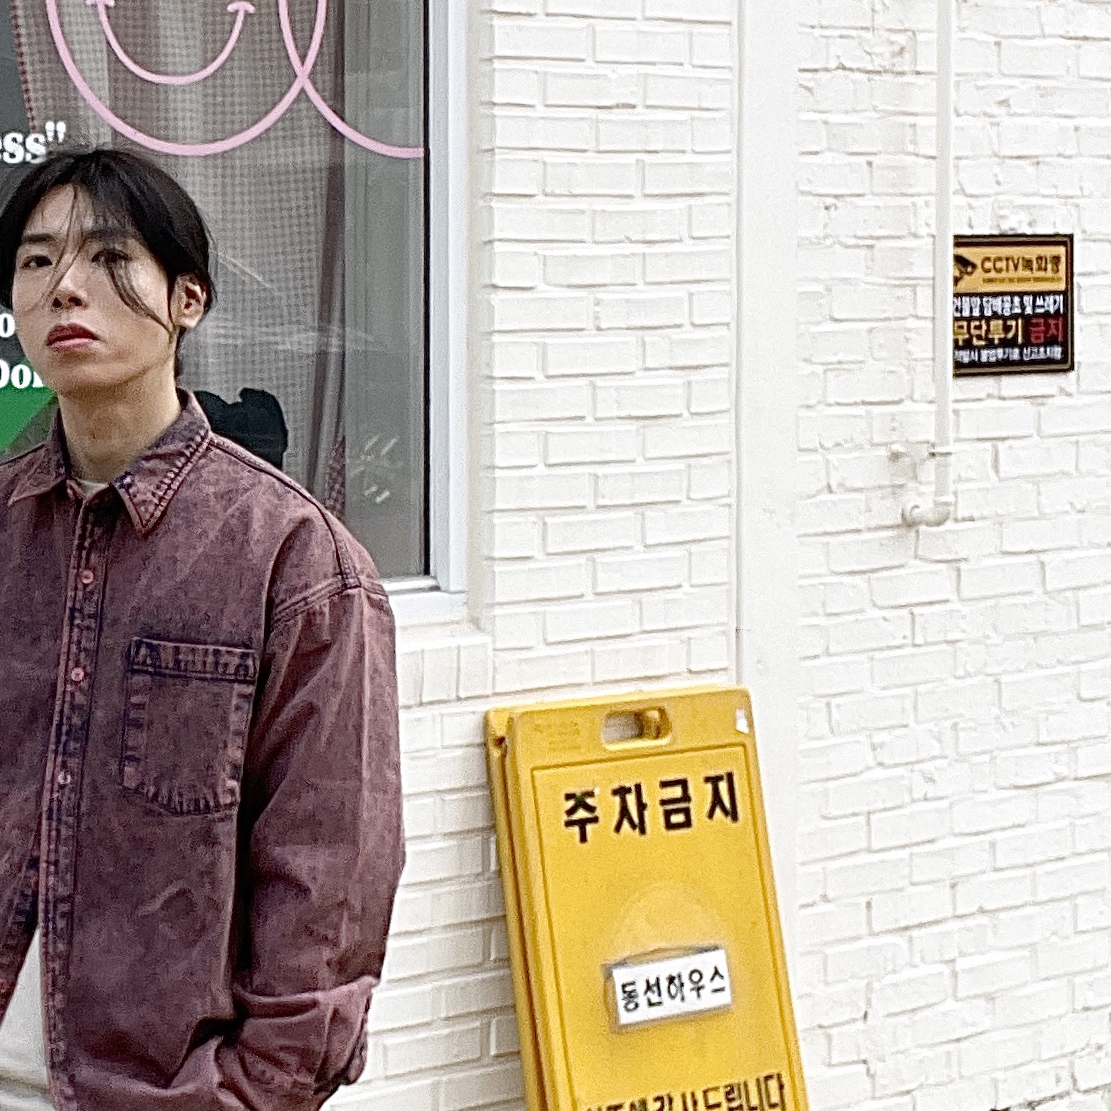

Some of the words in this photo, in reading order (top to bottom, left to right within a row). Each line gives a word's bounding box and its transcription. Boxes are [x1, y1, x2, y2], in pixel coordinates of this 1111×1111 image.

[1029, 317, 1064, 344] 금지
[563, 770, 739, 844] 주차금지
[621, 964, 727, 1014] 동선하우스
